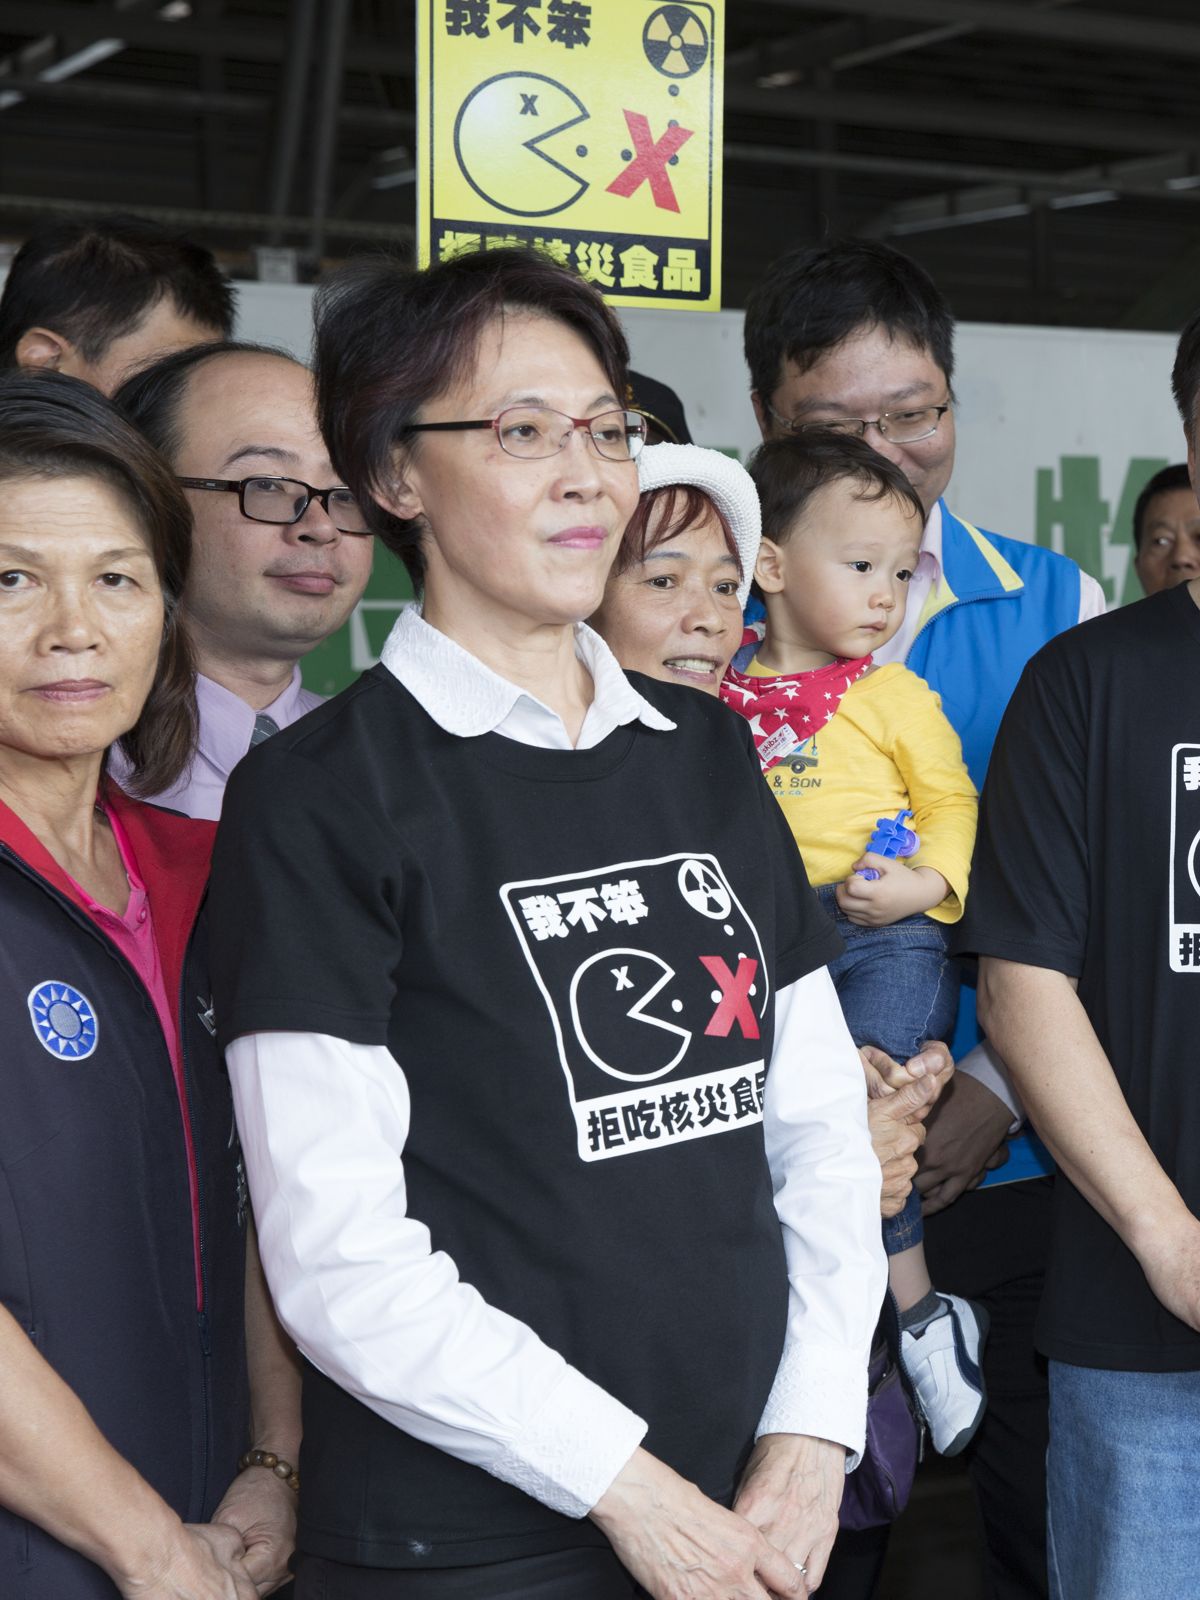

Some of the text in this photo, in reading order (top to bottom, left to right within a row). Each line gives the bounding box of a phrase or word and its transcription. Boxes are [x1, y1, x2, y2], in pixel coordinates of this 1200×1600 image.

[446, 0, 591, 49] 我不笨
[790, 777, 822, 788] SON
[518, 879, 649, 942] 我不笨
